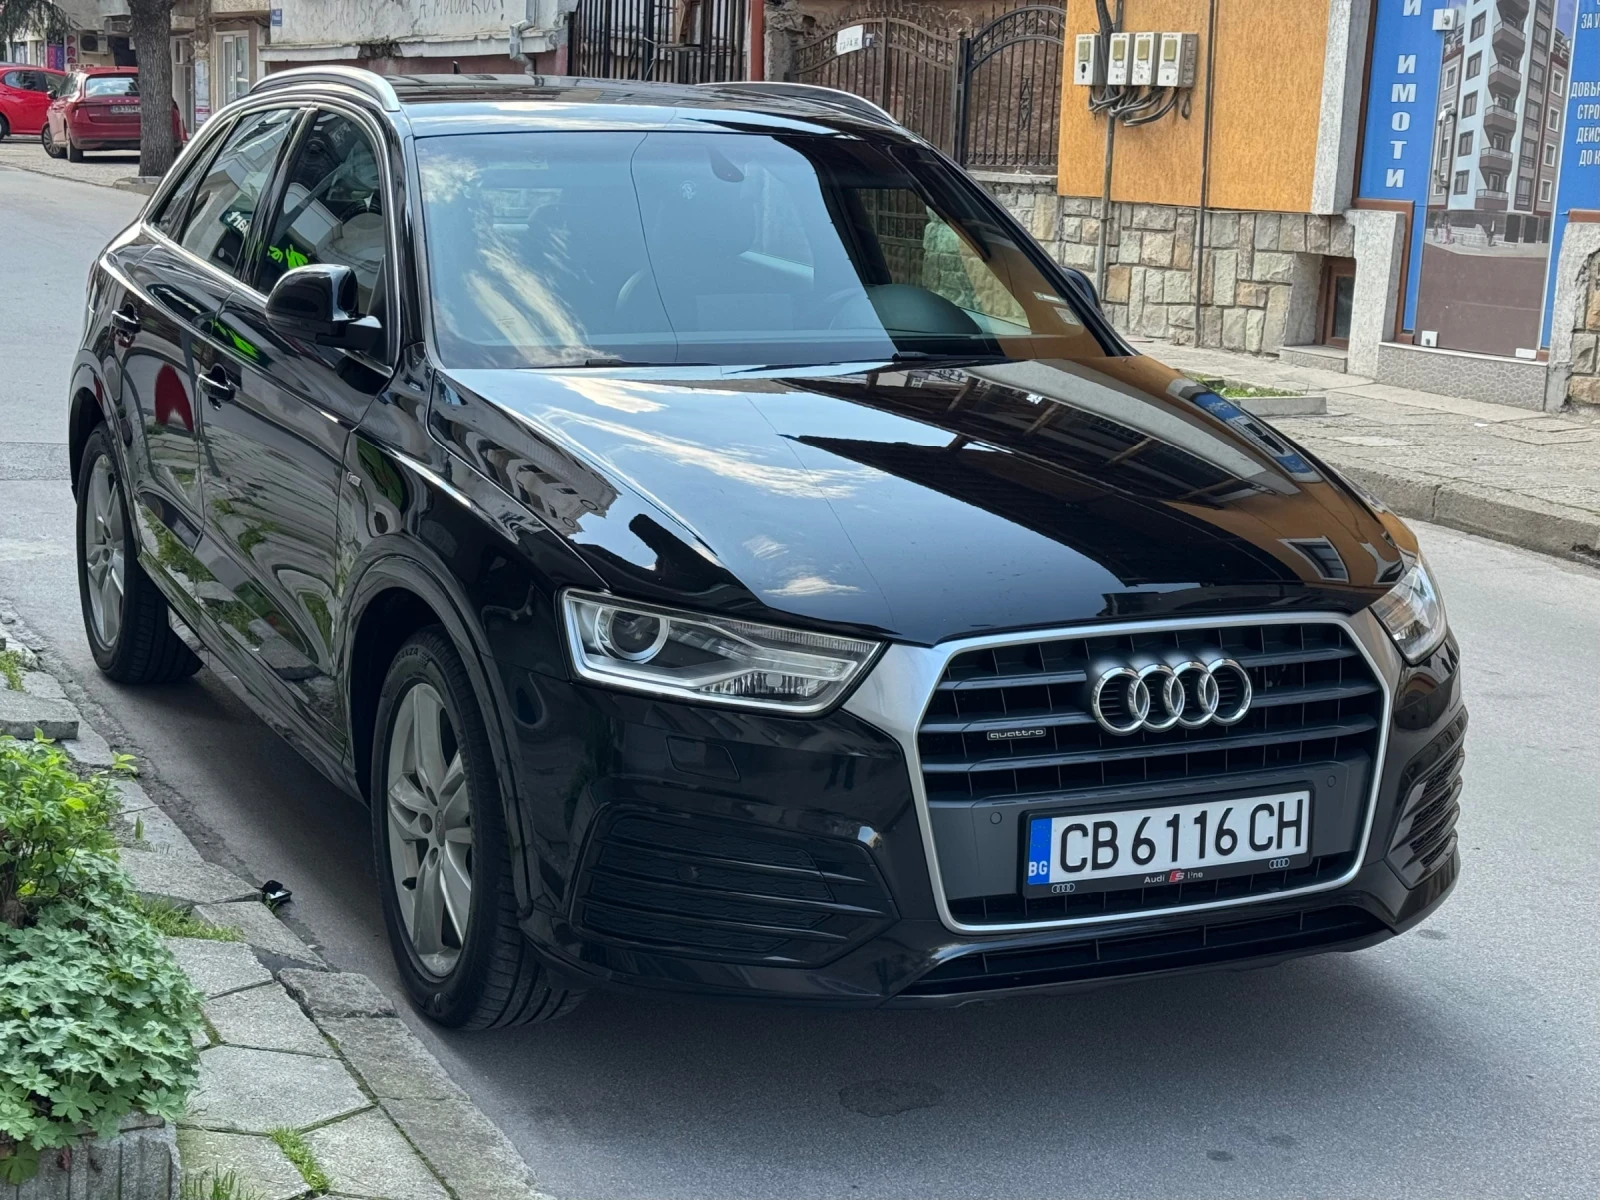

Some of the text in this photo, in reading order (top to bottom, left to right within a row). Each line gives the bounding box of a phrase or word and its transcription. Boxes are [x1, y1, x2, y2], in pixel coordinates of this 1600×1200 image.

[1581, 13, 1593, 29] ЗА
[1386, 55, 1417, 188] ИМОТИ
[1578, 149, 1593, 167] ДО
[990, 729, 1044, 739] quattro
[1028, 861, 1048, 876] BG
[1144, 874, 1165, 884] Audi
